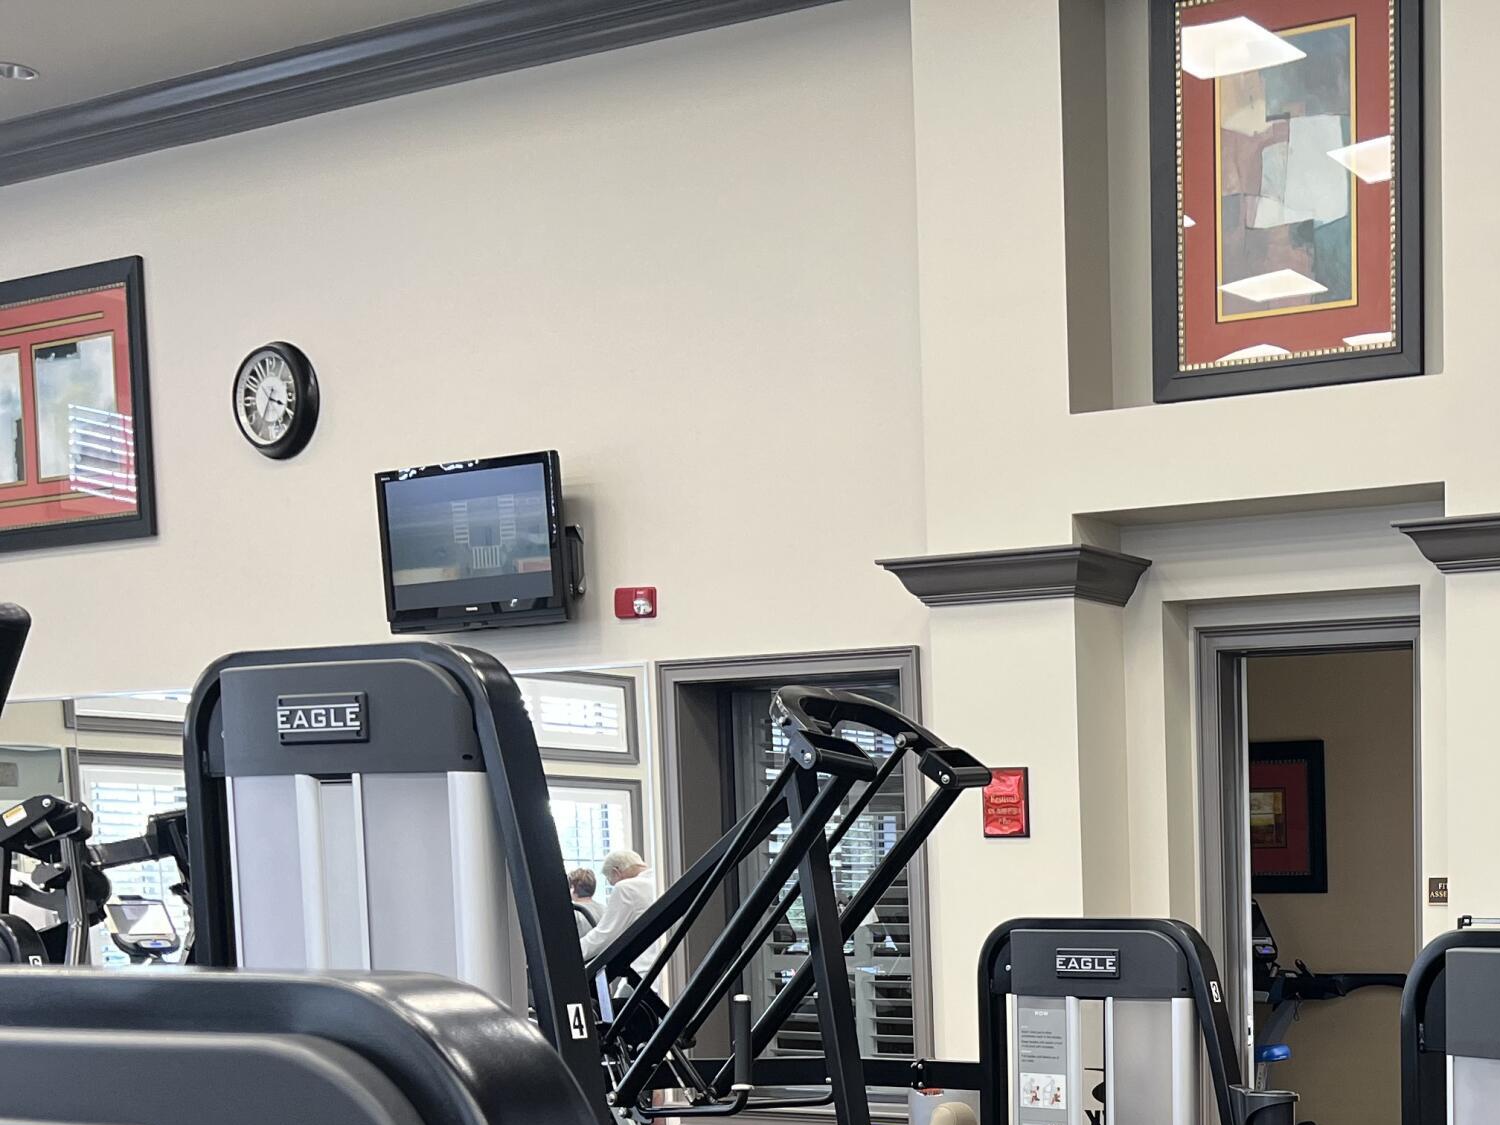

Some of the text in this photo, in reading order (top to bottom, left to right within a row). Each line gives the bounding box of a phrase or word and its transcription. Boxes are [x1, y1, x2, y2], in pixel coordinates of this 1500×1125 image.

[277, 707, 361, 729] EAGLE
[1055, 957, 1117, 970] EAGLE
[1211, 983, 1219, 1001] 3
[572, 1005, 585, 1036] 4
